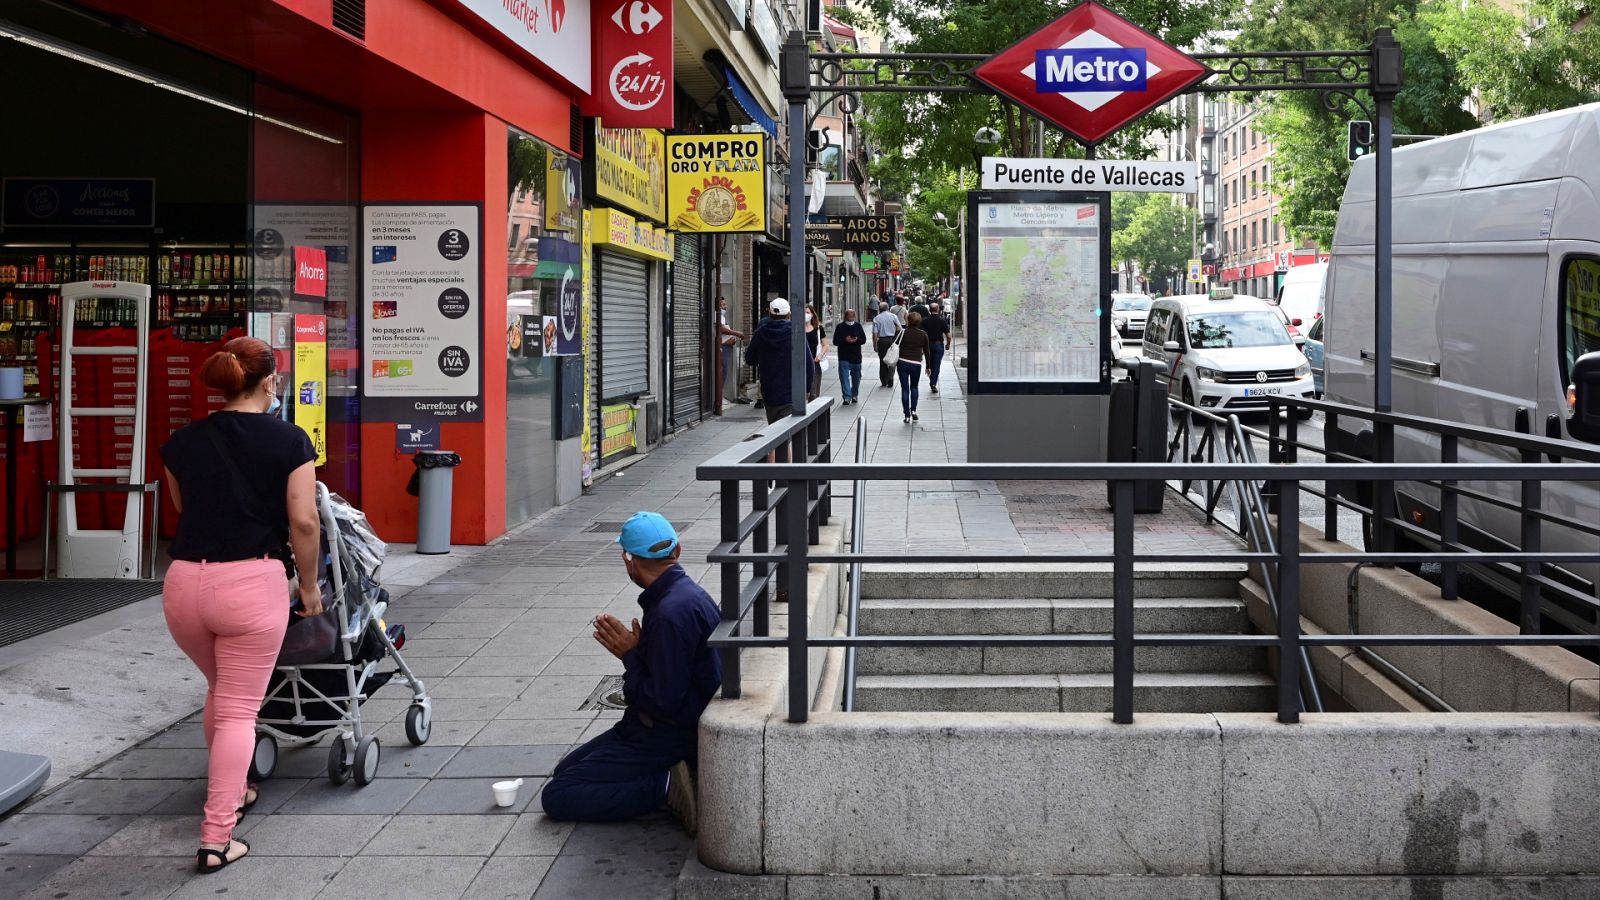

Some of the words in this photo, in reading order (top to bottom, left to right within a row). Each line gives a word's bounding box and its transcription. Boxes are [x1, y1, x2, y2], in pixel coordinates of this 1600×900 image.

[1046, 55, 1139, 83] Metro
[620, 74, 660, 93] 24/7
[672, 140, 758, 160] COMPRO
[672, 161, 699, 172] ORO
[703, 161, 712, 172] Y
[716, 159, 760, 172] PLATA
[995, 163, 1064, 184] Puente
[1072, 165, 1096, 184] de
[1102, 166, 1184, 186] Vallecas
[686, 187, 701, 212] LOS
[703, 176, 747, 210] ADOLFOS
[448, 231, 459, 244] 3
[805, 232, 830, 241] ANAMÁ
[843, 232, 890, 243] IANOS
[300, 262, 324, 280] Ahorra
[415, 402, 457, 410] Carrefour
